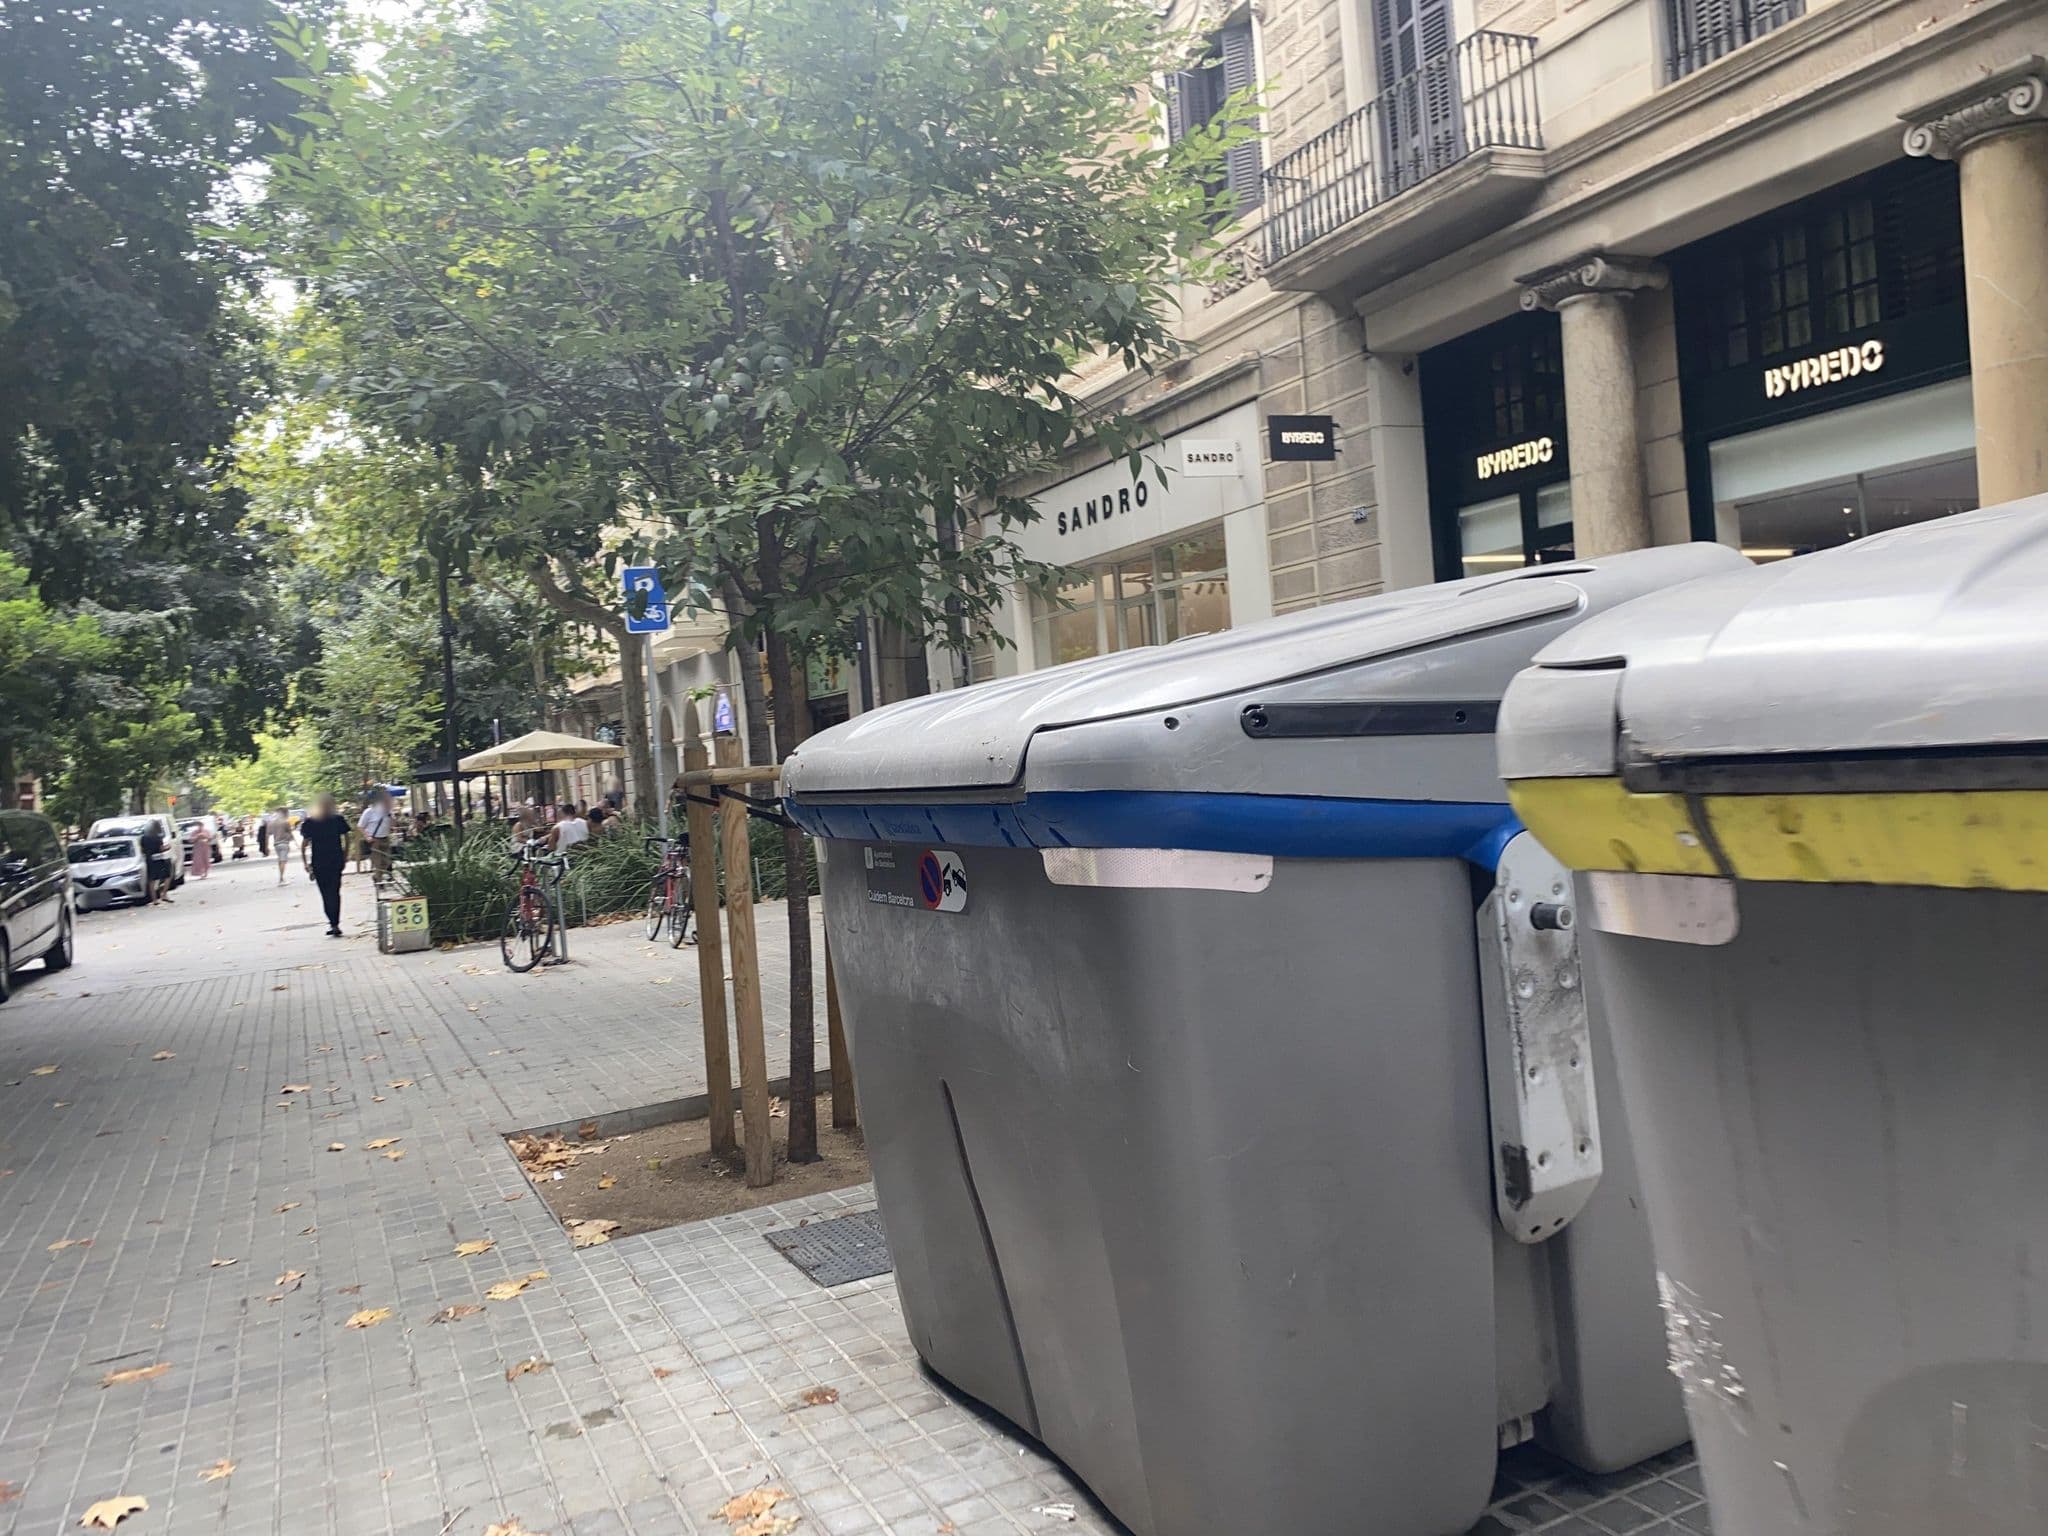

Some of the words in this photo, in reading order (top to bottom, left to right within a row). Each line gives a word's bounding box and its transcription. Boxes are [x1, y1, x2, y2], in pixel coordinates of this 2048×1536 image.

[1764, 339, 1884, 399] BYREDO
[1281, 431, 1325, 445] BYREDO
[1187, 452, 1234, 463] SANDRO
[1476, 436, 1553, 480] BYREDO
[1057, 480, 1148, 536] SANDRO
[887, 891, 914, 907] Barcelona
